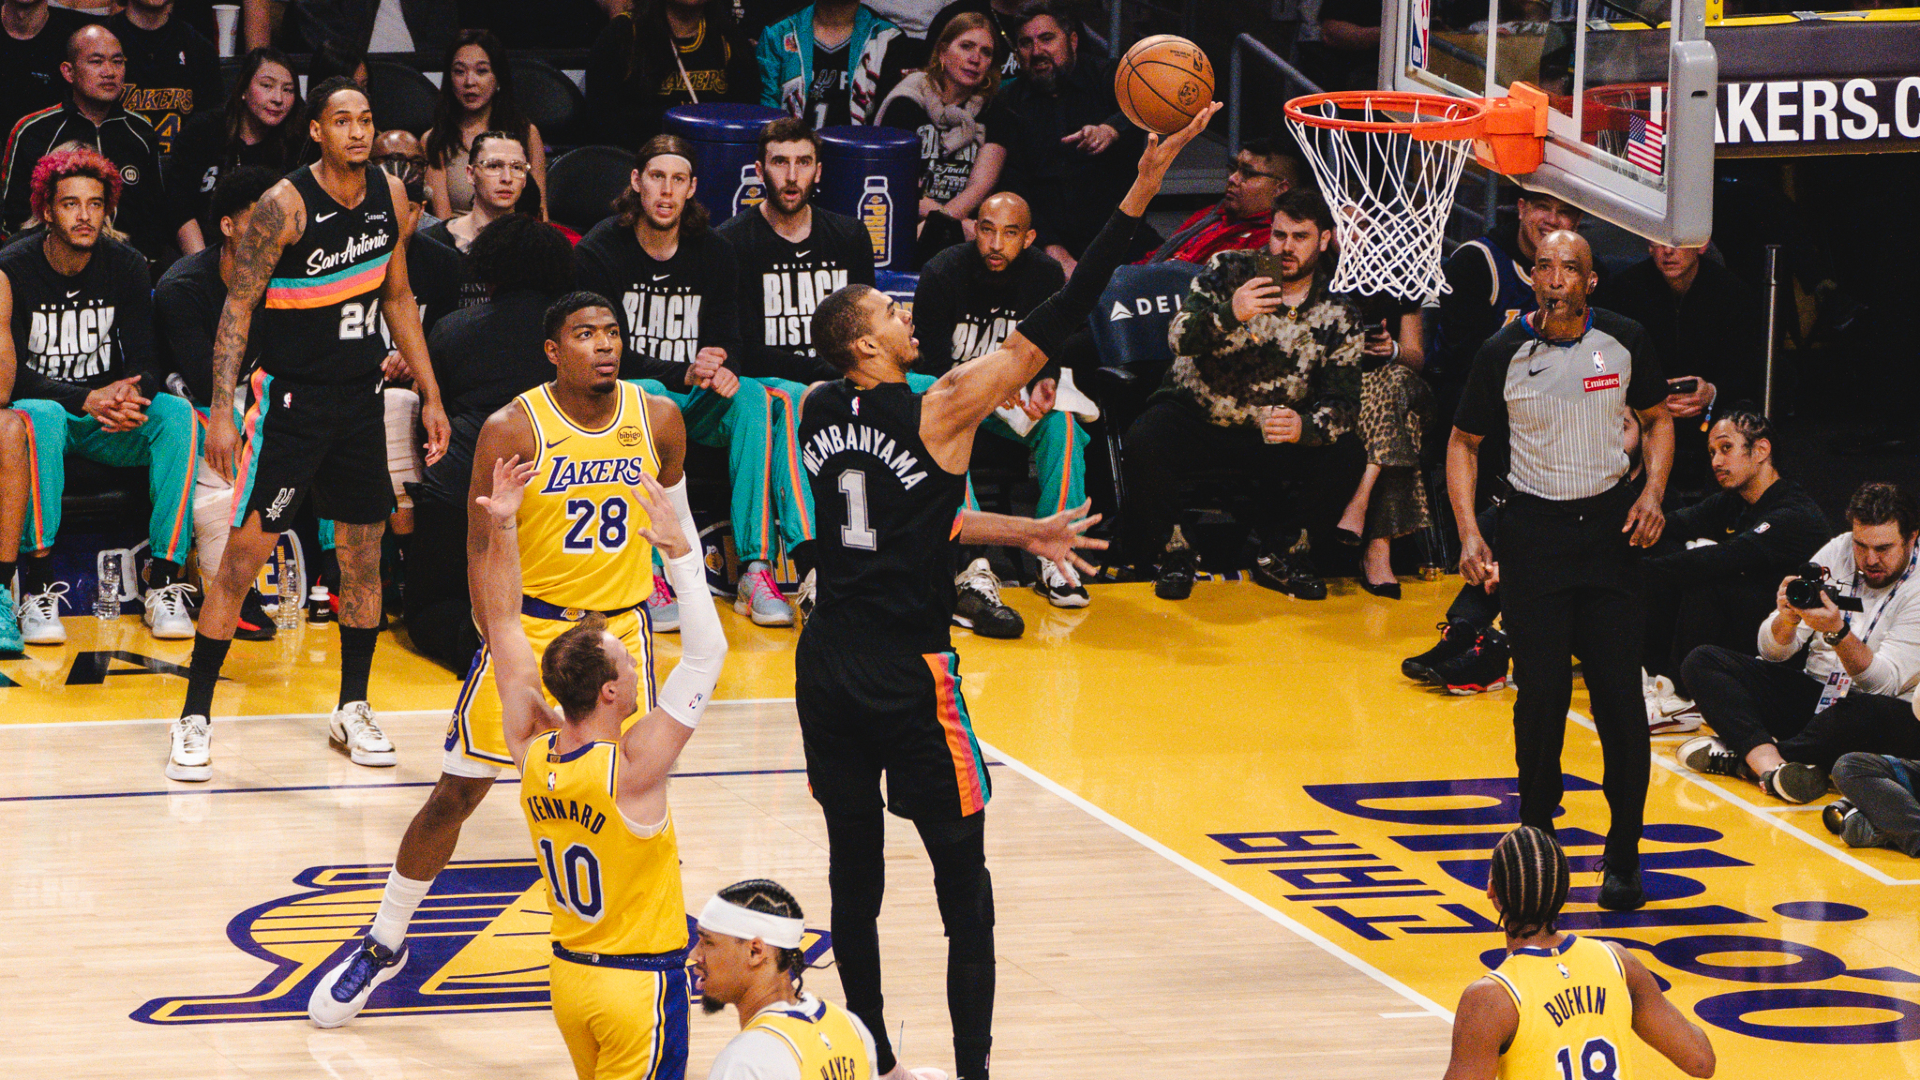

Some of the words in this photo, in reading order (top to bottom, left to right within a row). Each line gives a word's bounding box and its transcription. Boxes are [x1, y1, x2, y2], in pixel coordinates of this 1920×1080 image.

[119, 83, 193, 114] LAKERS
[1650, 77, 1920, 145] LKERS.C
[306, 248, 340, 276] San
[341, 228, 389, 264] Antonio
[633, 283, 669, 293] BUILT
[28, 306, 115, 355] BLACK
[338, 298, 380, 340] 24
[622, 291, 702, 340] BLACK
[765, 315, 812, 346] HIST
[1584, 378, 1619, 389] Emirates
[619, 430, 641, 440] bibigo
[539, 455, 643, 494] LAKERS
[802, 423, 928, 491] WEMBANYAMA
[562, 496, 629, 554] 28
[838, 468, 878, 551] 1
[526, 796, 607, 835] KENNARD
[539, 837, 606, 924] 10
[1543, 985, 1606, 1028] BUFKIN
